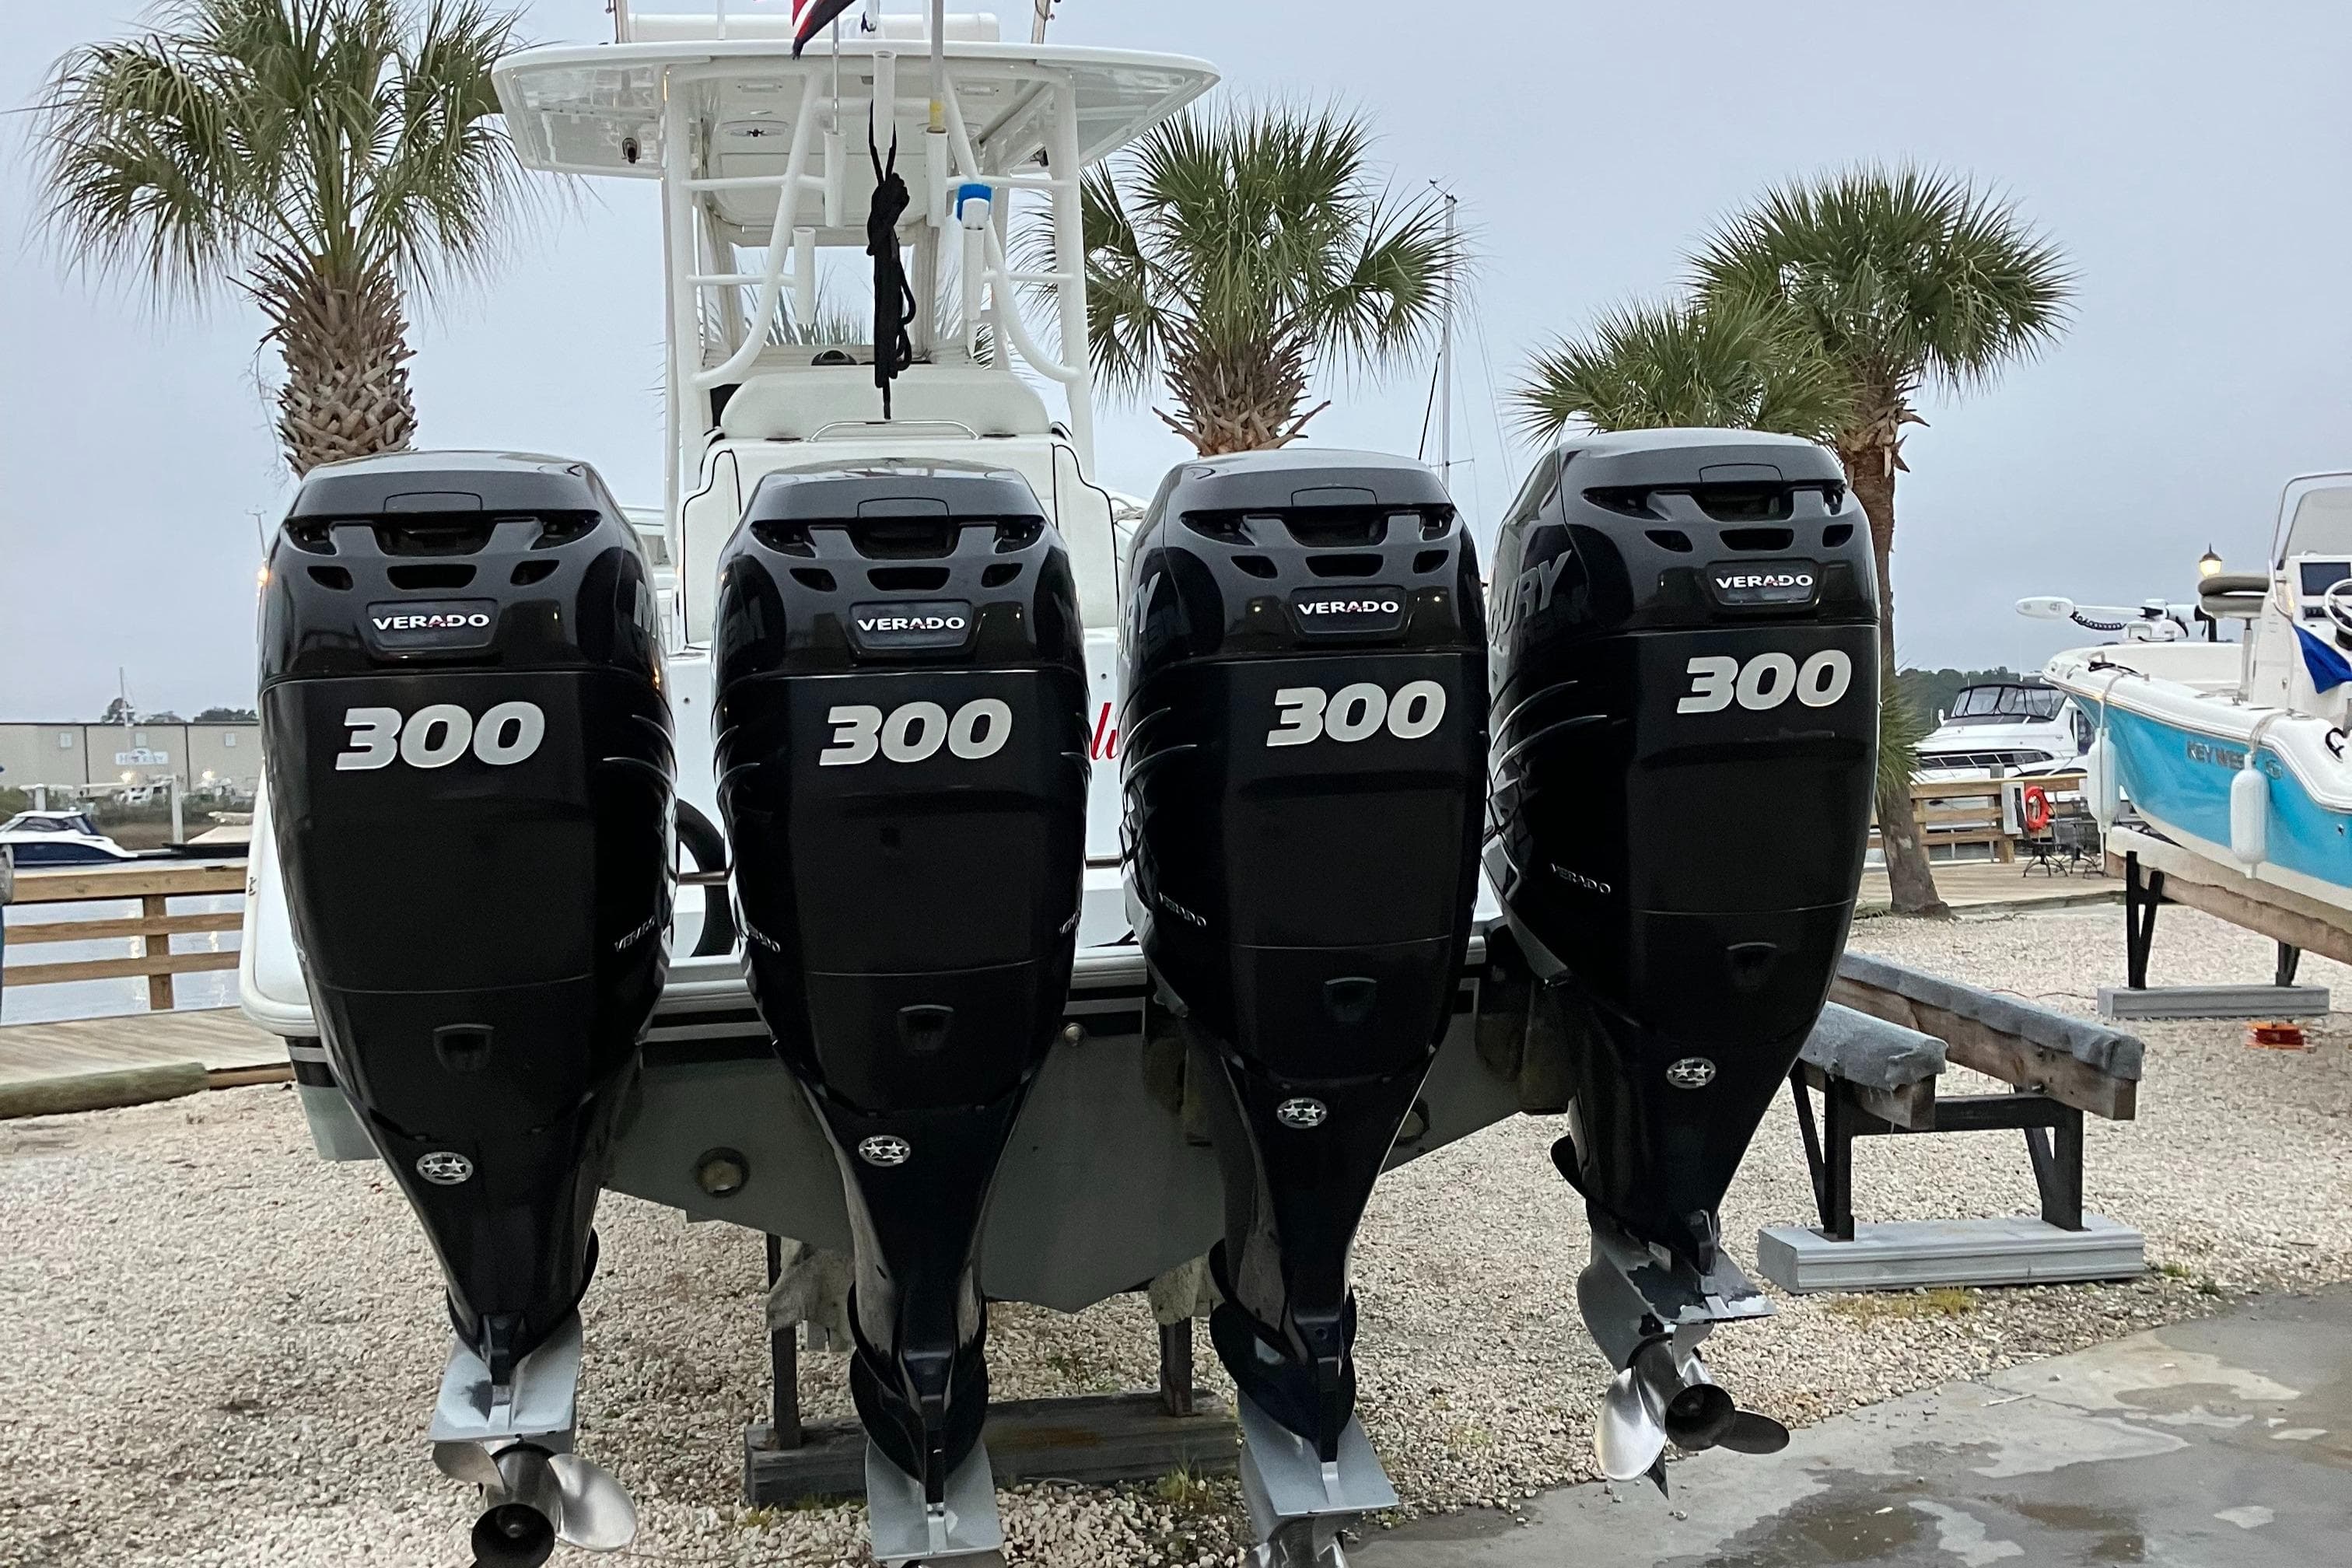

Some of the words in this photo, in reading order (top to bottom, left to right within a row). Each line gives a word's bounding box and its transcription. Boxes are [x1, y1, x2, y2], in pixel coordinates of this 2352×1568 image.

[1715, 574, 1815, 589] VERADO
[372, 613, 490, 630] VERADO
[857, 616, 965, 632] VERADO
[1297, 600, 1400, 615] VERADO
[1676, 649, 1852, 714] 300
[819, 698, 1013, 766] 300
[1266, 680, 1447, 747] 300
[334, 701, 545, 771] 300
